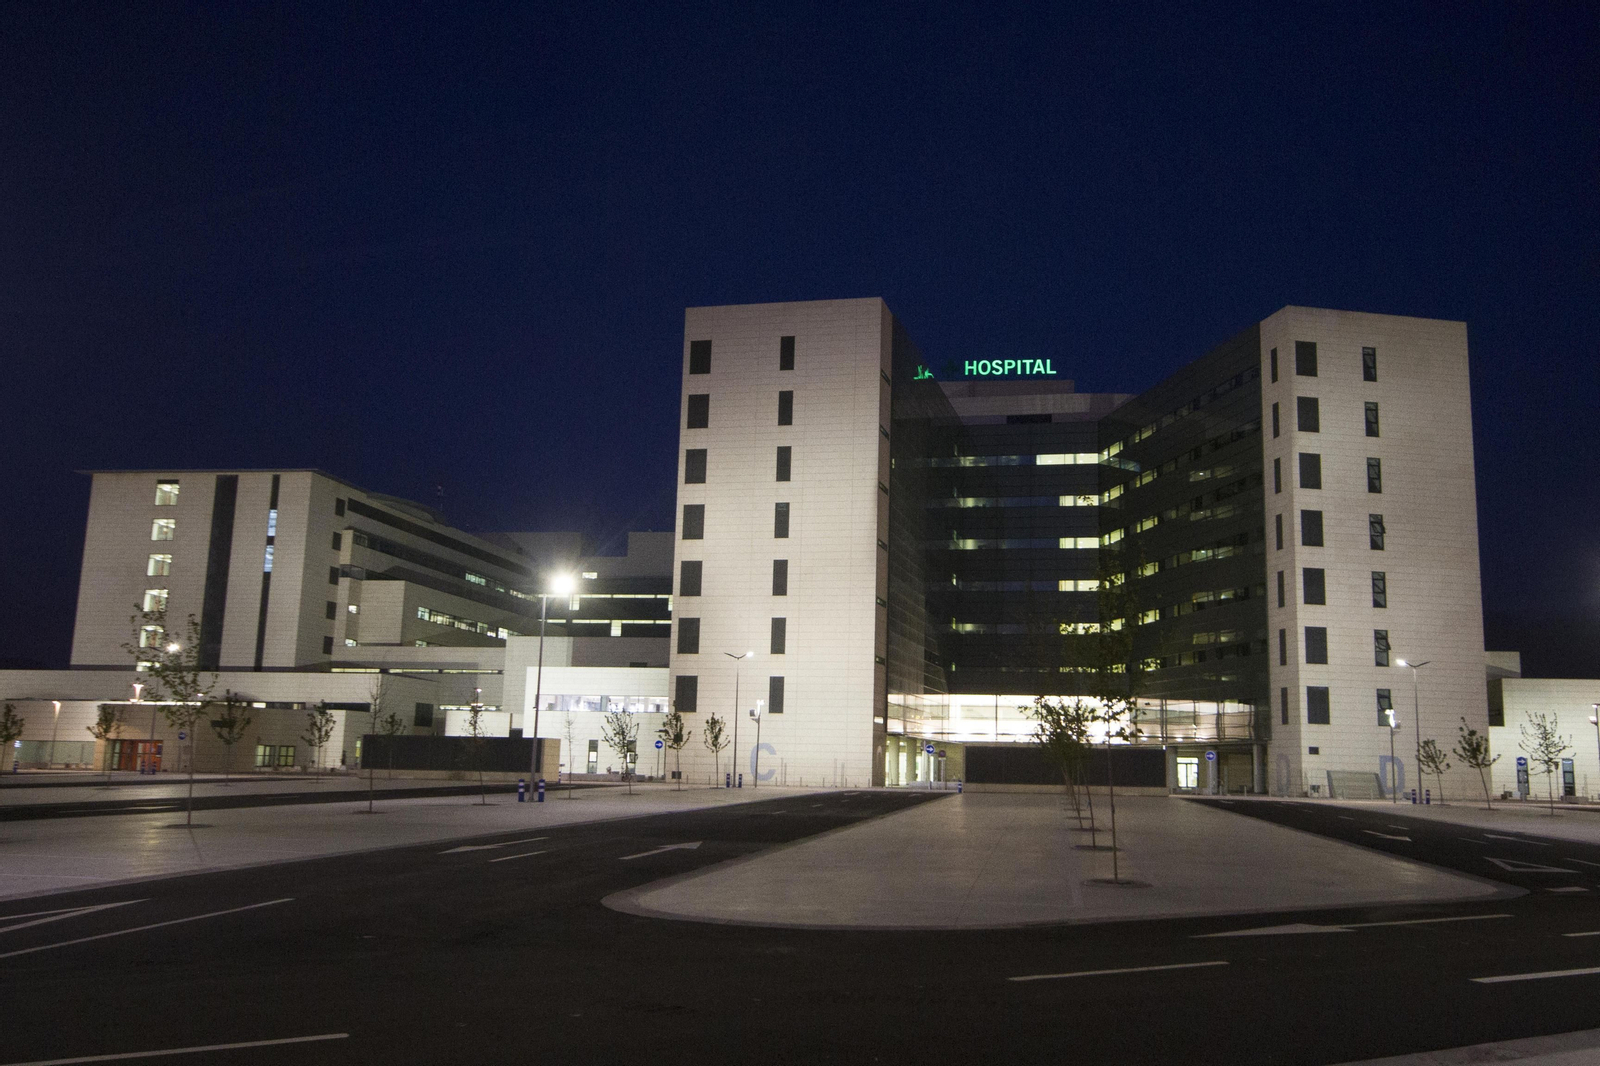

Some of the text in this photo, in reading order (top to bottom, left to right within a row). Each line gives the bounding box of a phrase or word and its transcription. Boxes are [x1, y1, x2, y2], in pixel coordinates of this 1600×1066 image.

[965, 359, 1057, 376] HOSPITAL
[750, 742, 777, 781] C
[1379, 755, 1405, 794] D
